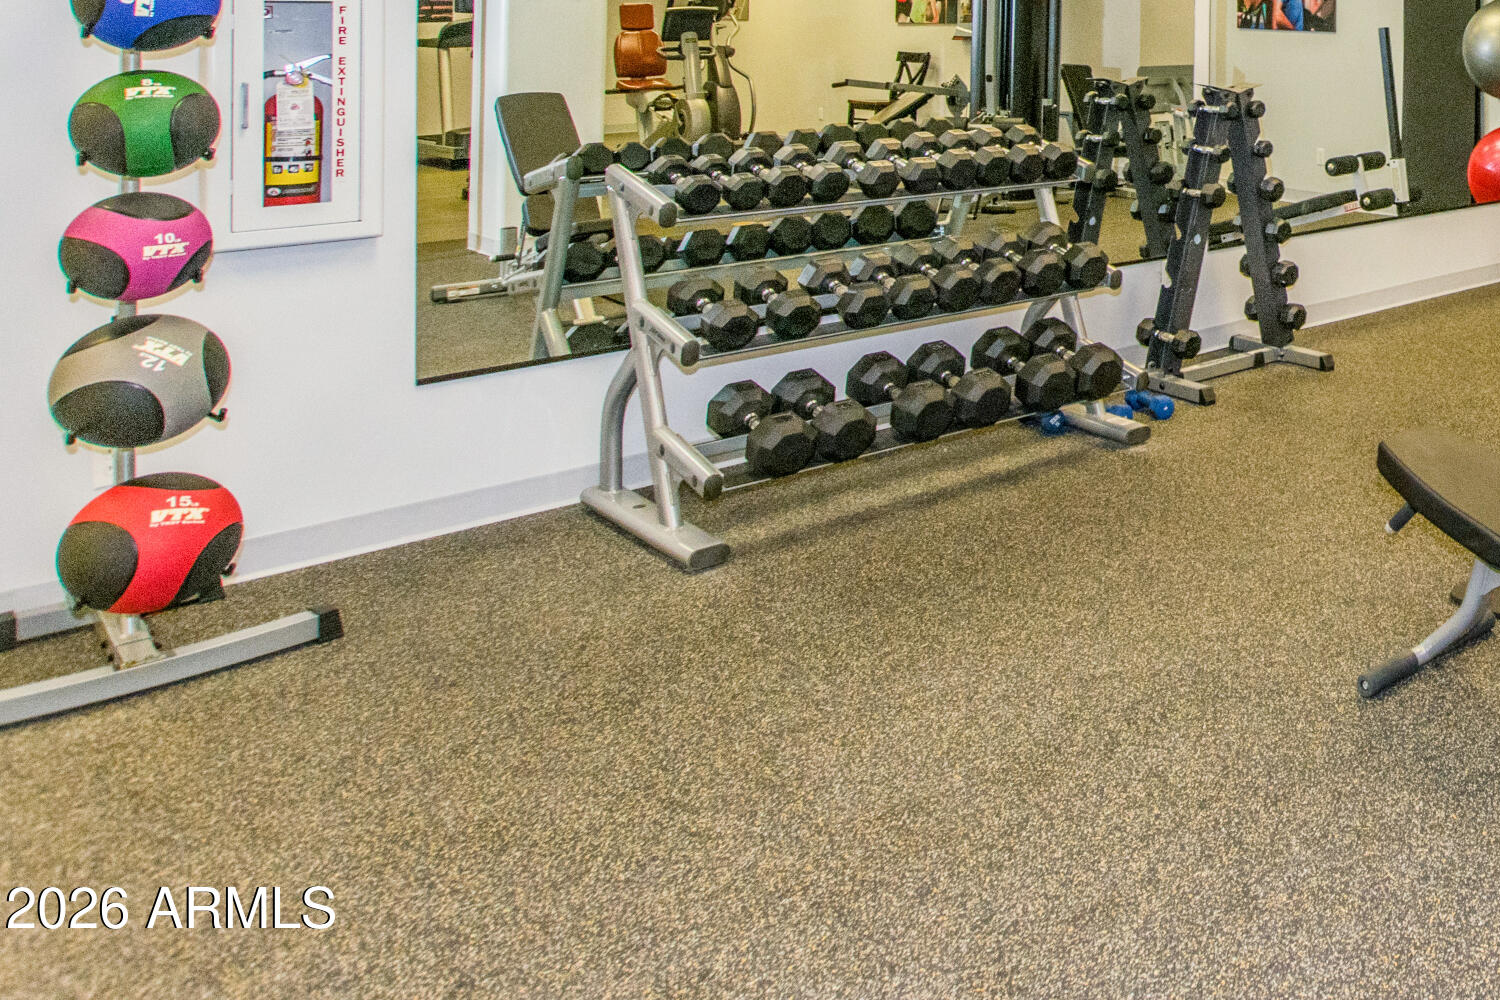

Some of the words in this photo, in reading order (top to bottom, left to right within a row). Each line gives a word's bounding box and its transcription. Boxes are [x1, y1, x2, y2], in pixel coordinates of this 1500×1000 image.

[338, 6, 347, 45] FIRE
[124, 86, 176, 97] VTX
[335, 56, 347, 178] EXTINGUISHER
[143, 241, 190, 257] VTX
[132, 339, 190, 367] VTX
[151, 507, 210, 523] VTX
